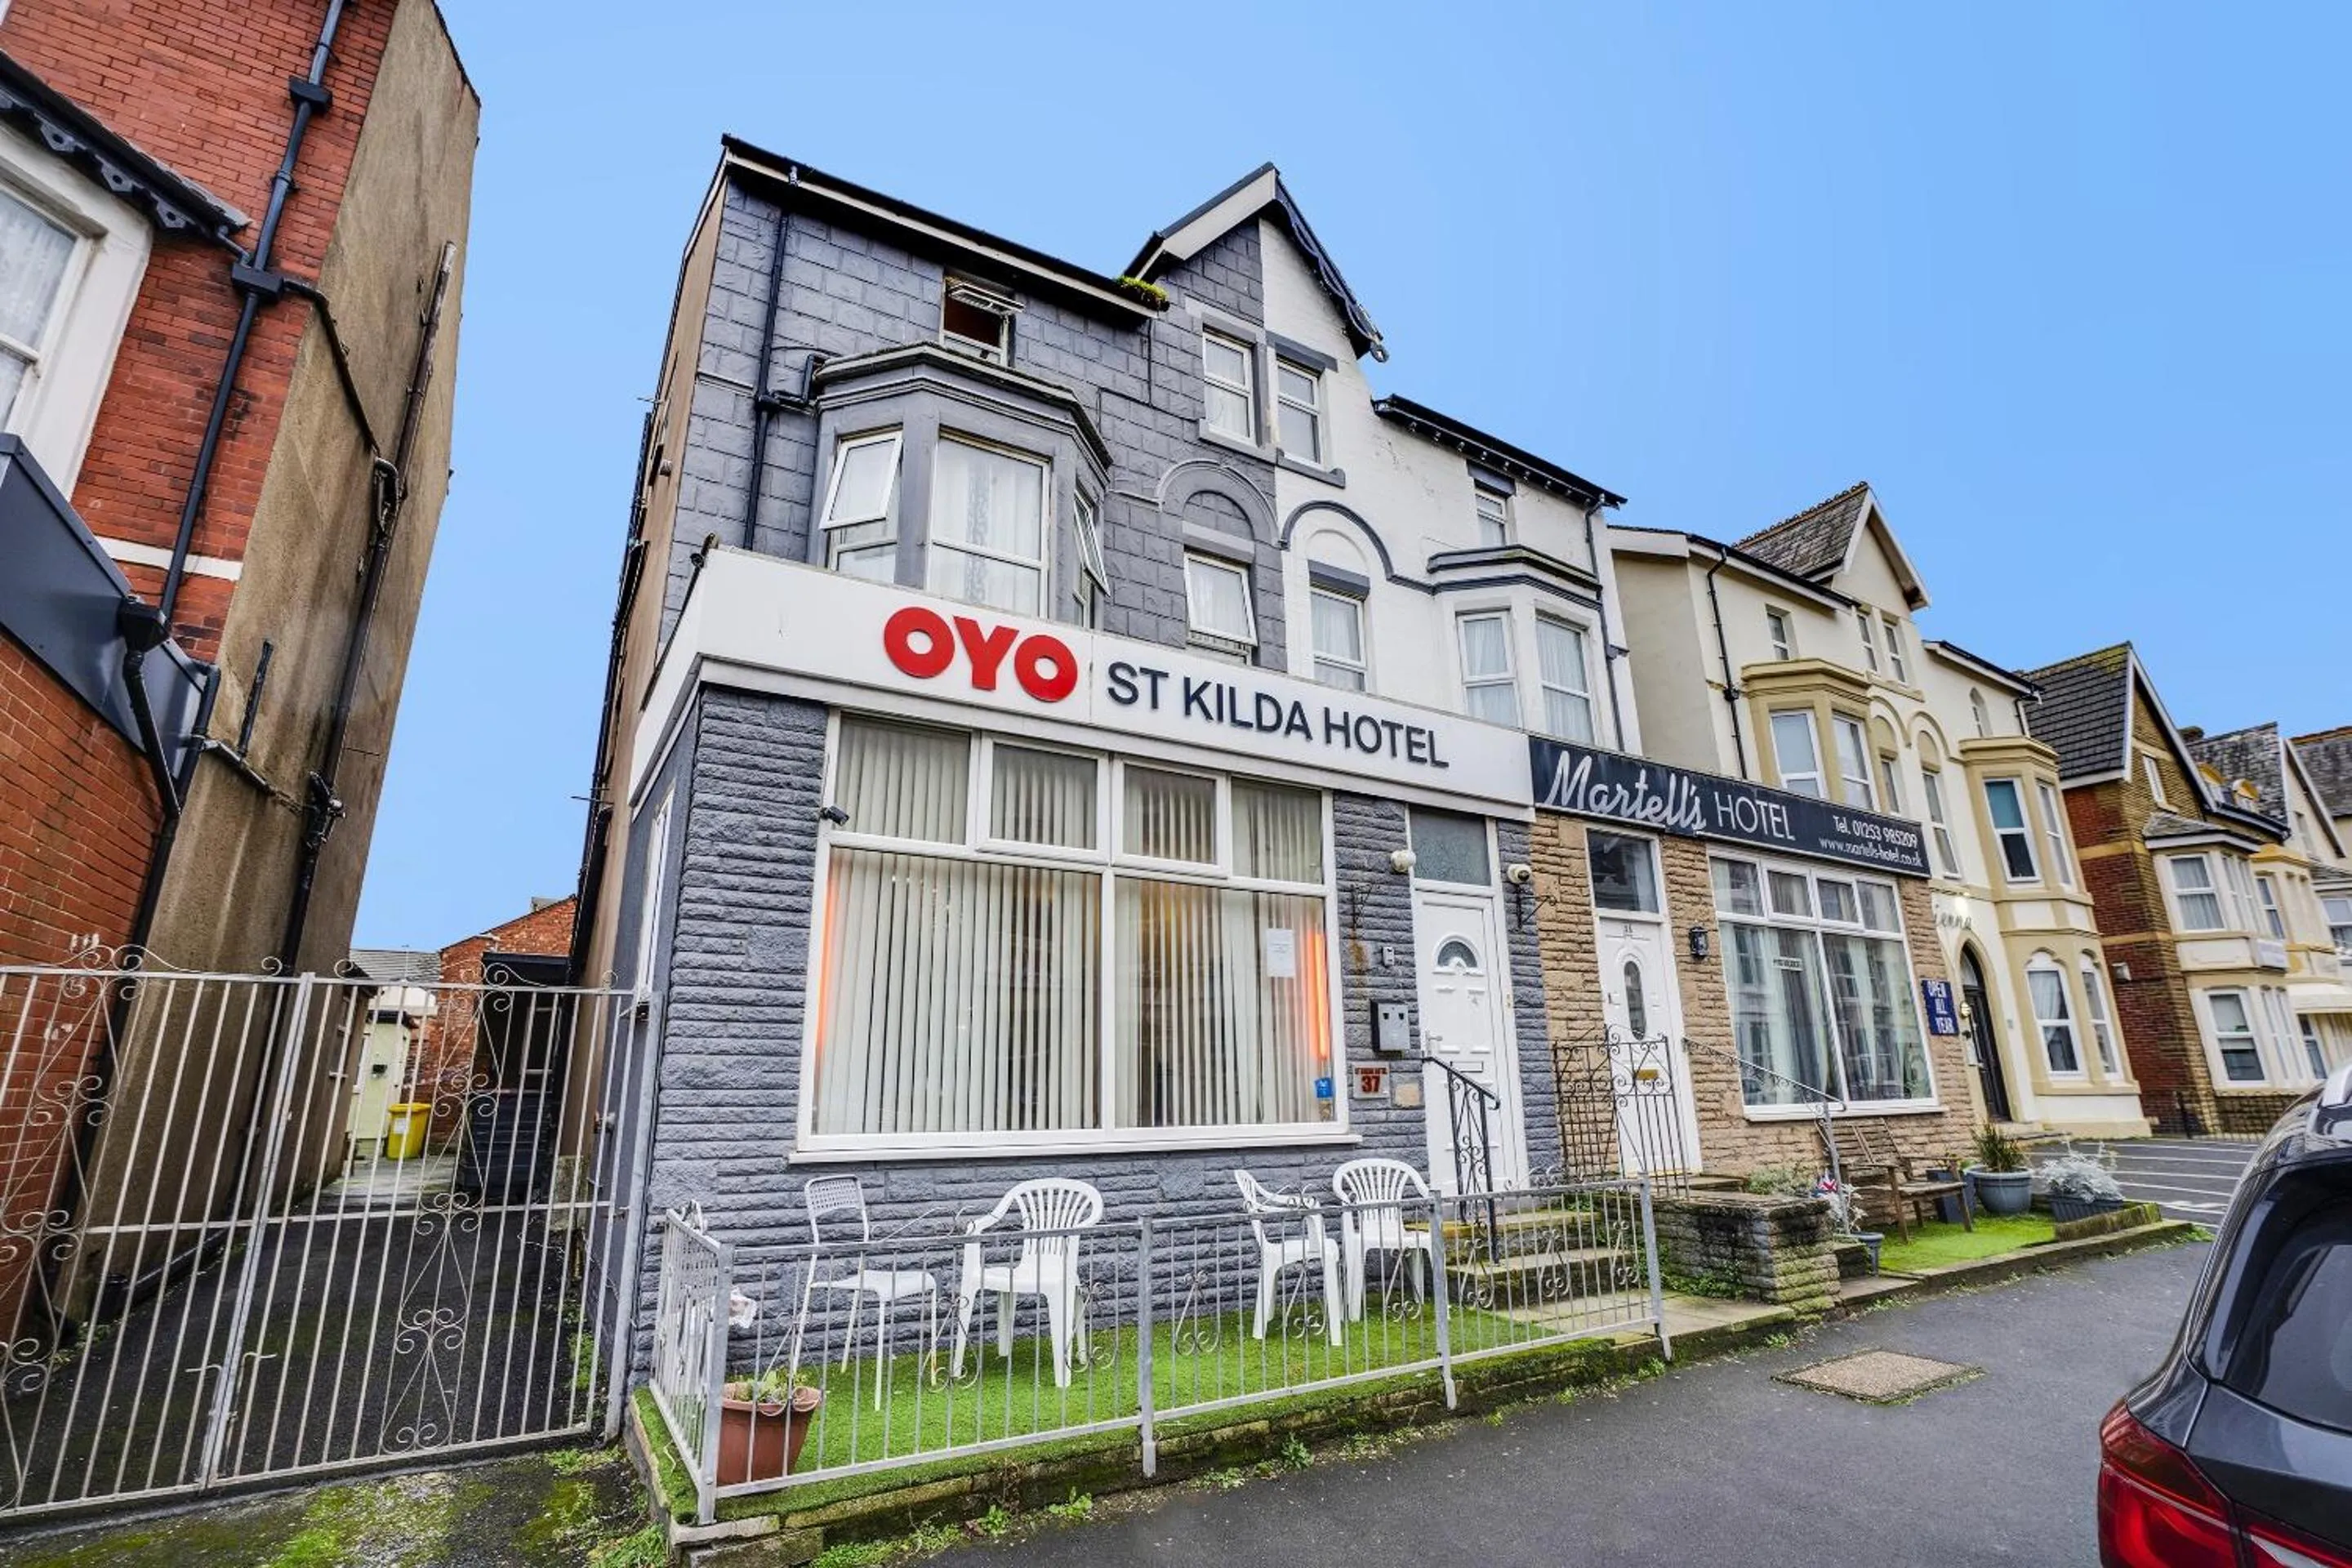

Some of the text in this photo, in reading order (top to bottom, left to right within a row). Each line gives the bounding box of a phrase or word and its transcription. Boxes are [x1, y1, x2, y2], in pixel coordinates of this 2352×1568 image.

[884, 607, 1078, 702] OYO
[1107, 662, 1450, 769] ST KILDA HOTEL
[1544, 750, 1795, 841] Martell's HOTEL
[1833, 815, 1851, 835] Tel.
[1852, 820, 1882, 840] 01253
[1927, 980, 1947, 997] OPEN
[1934, 998, 1949, 1014] ALL
[1936, 1017, 1955, 1034] YEAR
[1361, 1075, 1380, 1093] 37
